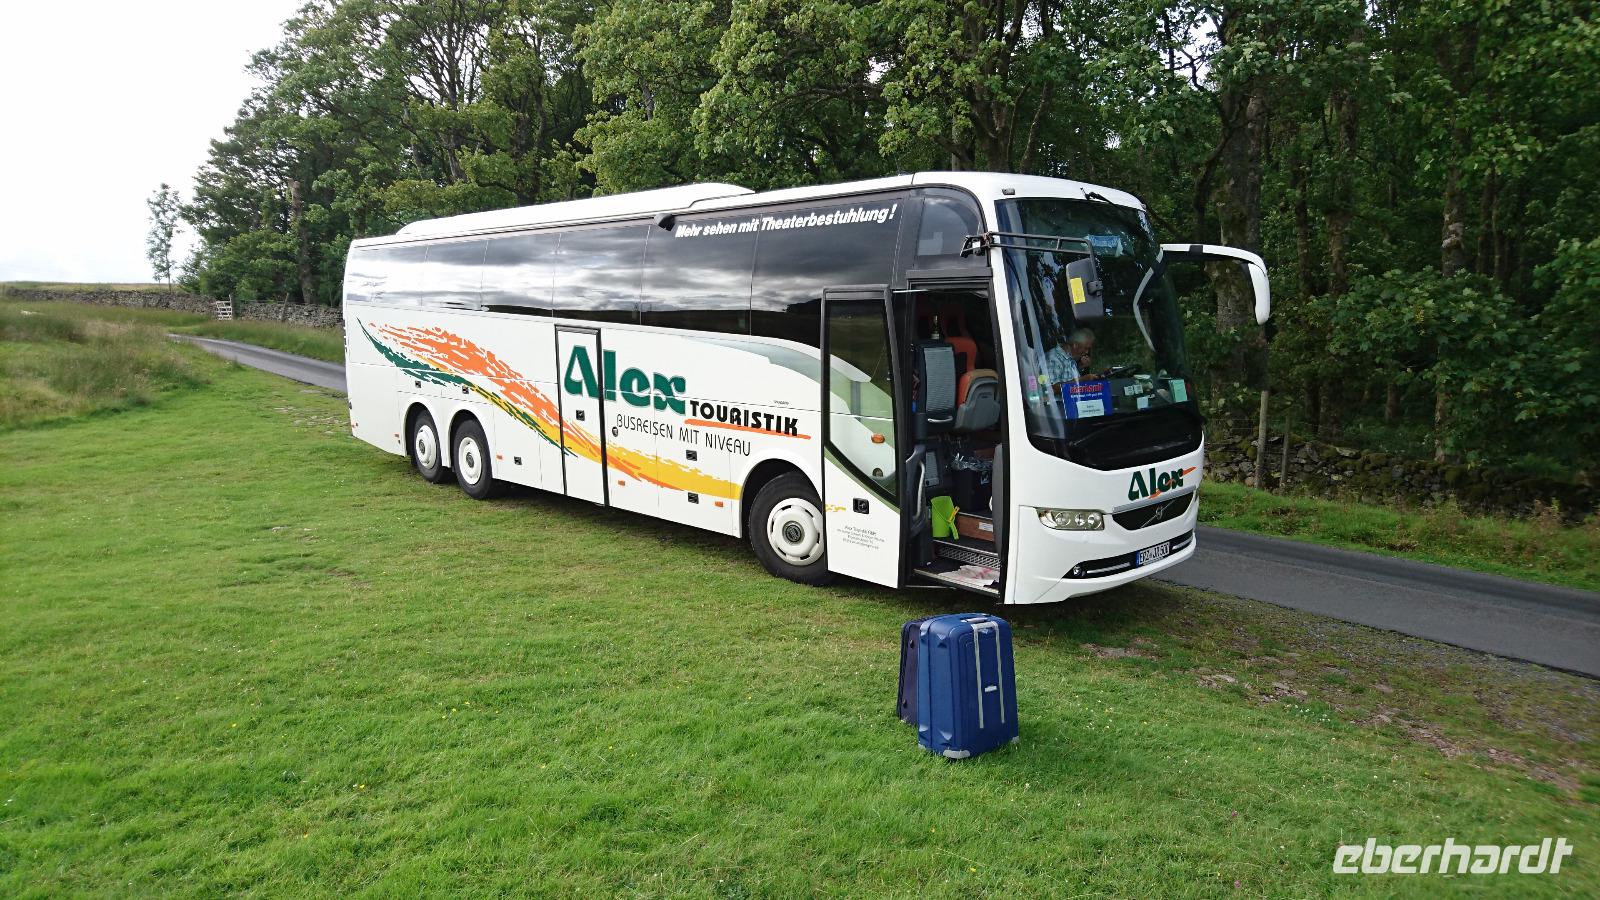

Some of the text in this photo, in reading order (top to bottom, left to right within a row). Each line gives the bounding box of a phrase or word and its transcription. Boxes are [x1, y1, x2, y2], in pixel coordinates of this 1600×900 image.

[675, 225, 702, 238] Mehr
[703, 222, 736, 236] sehen
[738, 218, 758, 233] mit
[564, 345, 686, 415] Alex
[616, 413, 751, 457] BUSREISEN MIT NIVEAU
[690, 400, 799, 436] TOURISTIK
[1128, 467, 1184, 501] Alex
